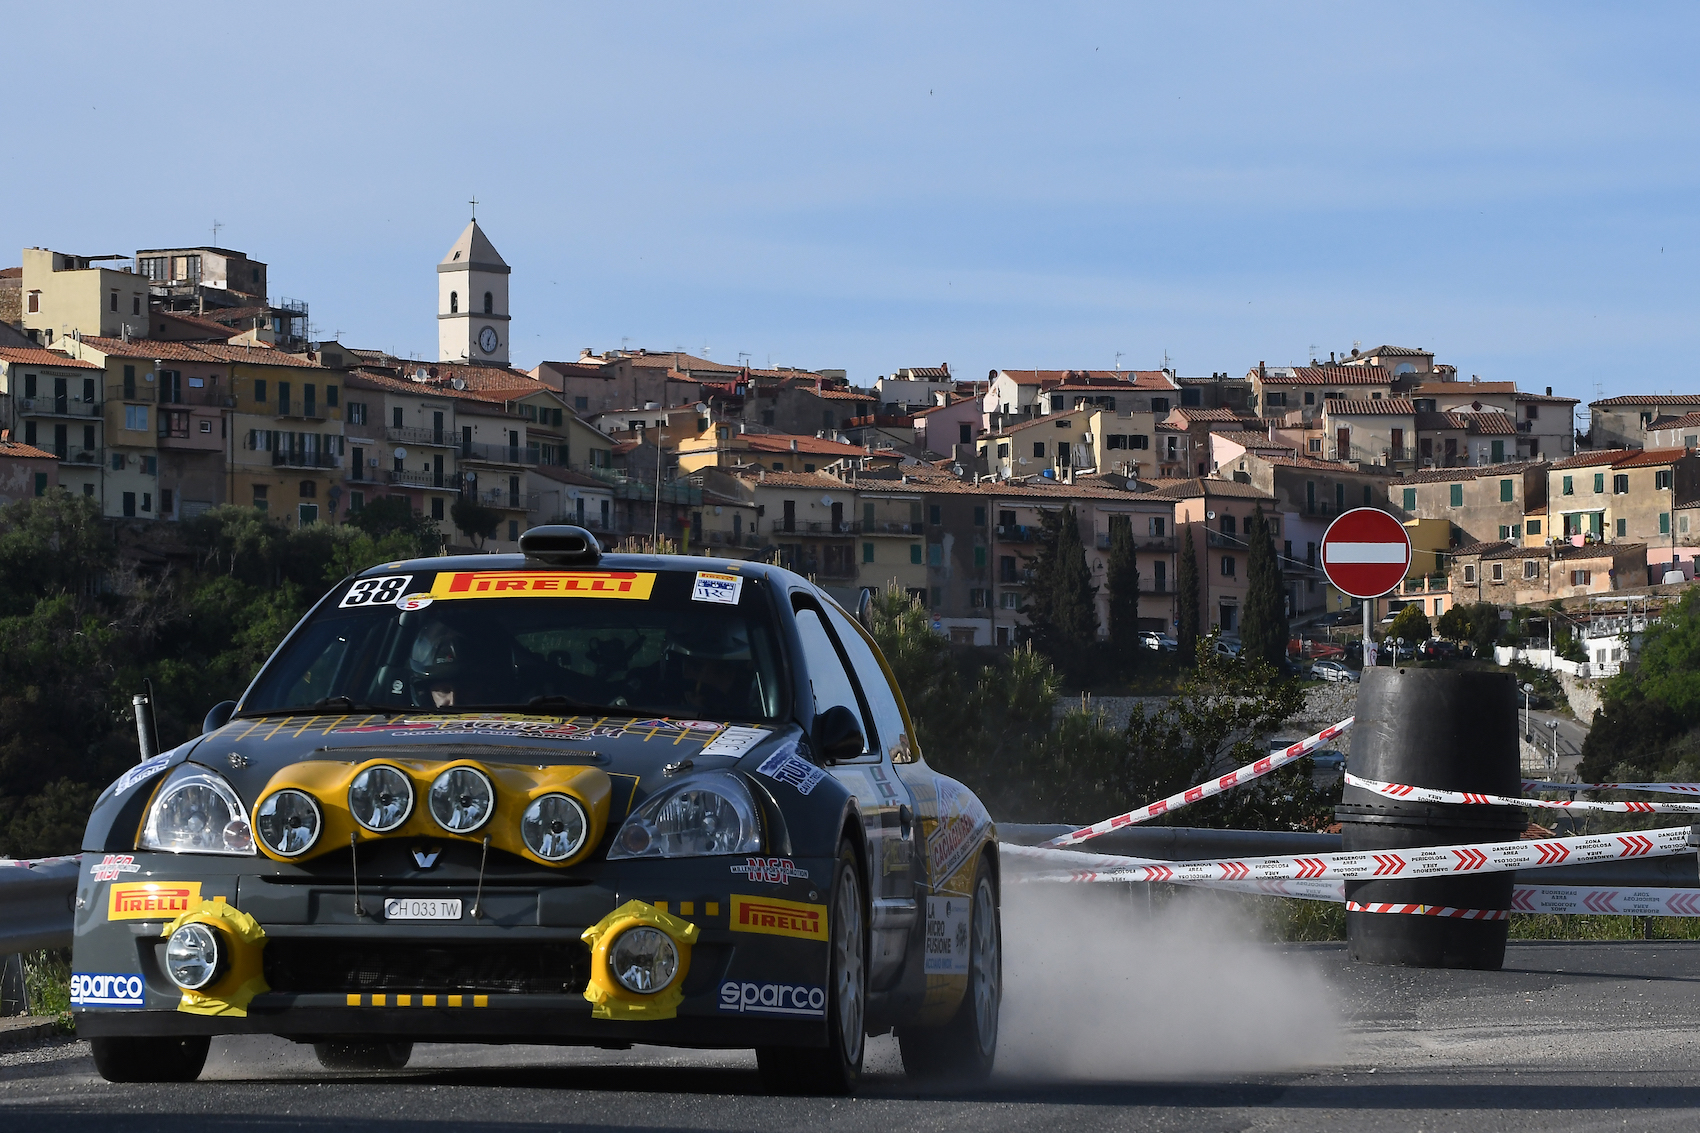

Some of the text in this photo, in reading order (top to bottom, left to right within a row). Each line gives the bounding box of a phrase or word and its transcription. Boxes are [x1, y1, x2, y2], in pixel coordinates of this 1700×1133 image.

[449, 571, 639, 593] PIRELLI
[346, 578, 407, 605] 38
[406, 601, 420, 609] S
[1658, 830, 1691, 838] DANGEROU
[1492, 844, 1528, 852] DANGEROUS
[1494, 856, 1530, 864] PERICOLOSA
[1577, 854, 1614, 862] DANGEROUS
[115, 889, 191, 913] PIRELLI
[388, 902, 459, 917] CH 033 TW
[739, 902, 820, 933] PIRELLI
[927, 902, 936, 919] LA
[927, 920, 946, 937] MICRO
[926, 937, 952, 954] FUSIONE
[70, 974, 143, 1005] sparco
[720, 981, 826, 1013] sparco
